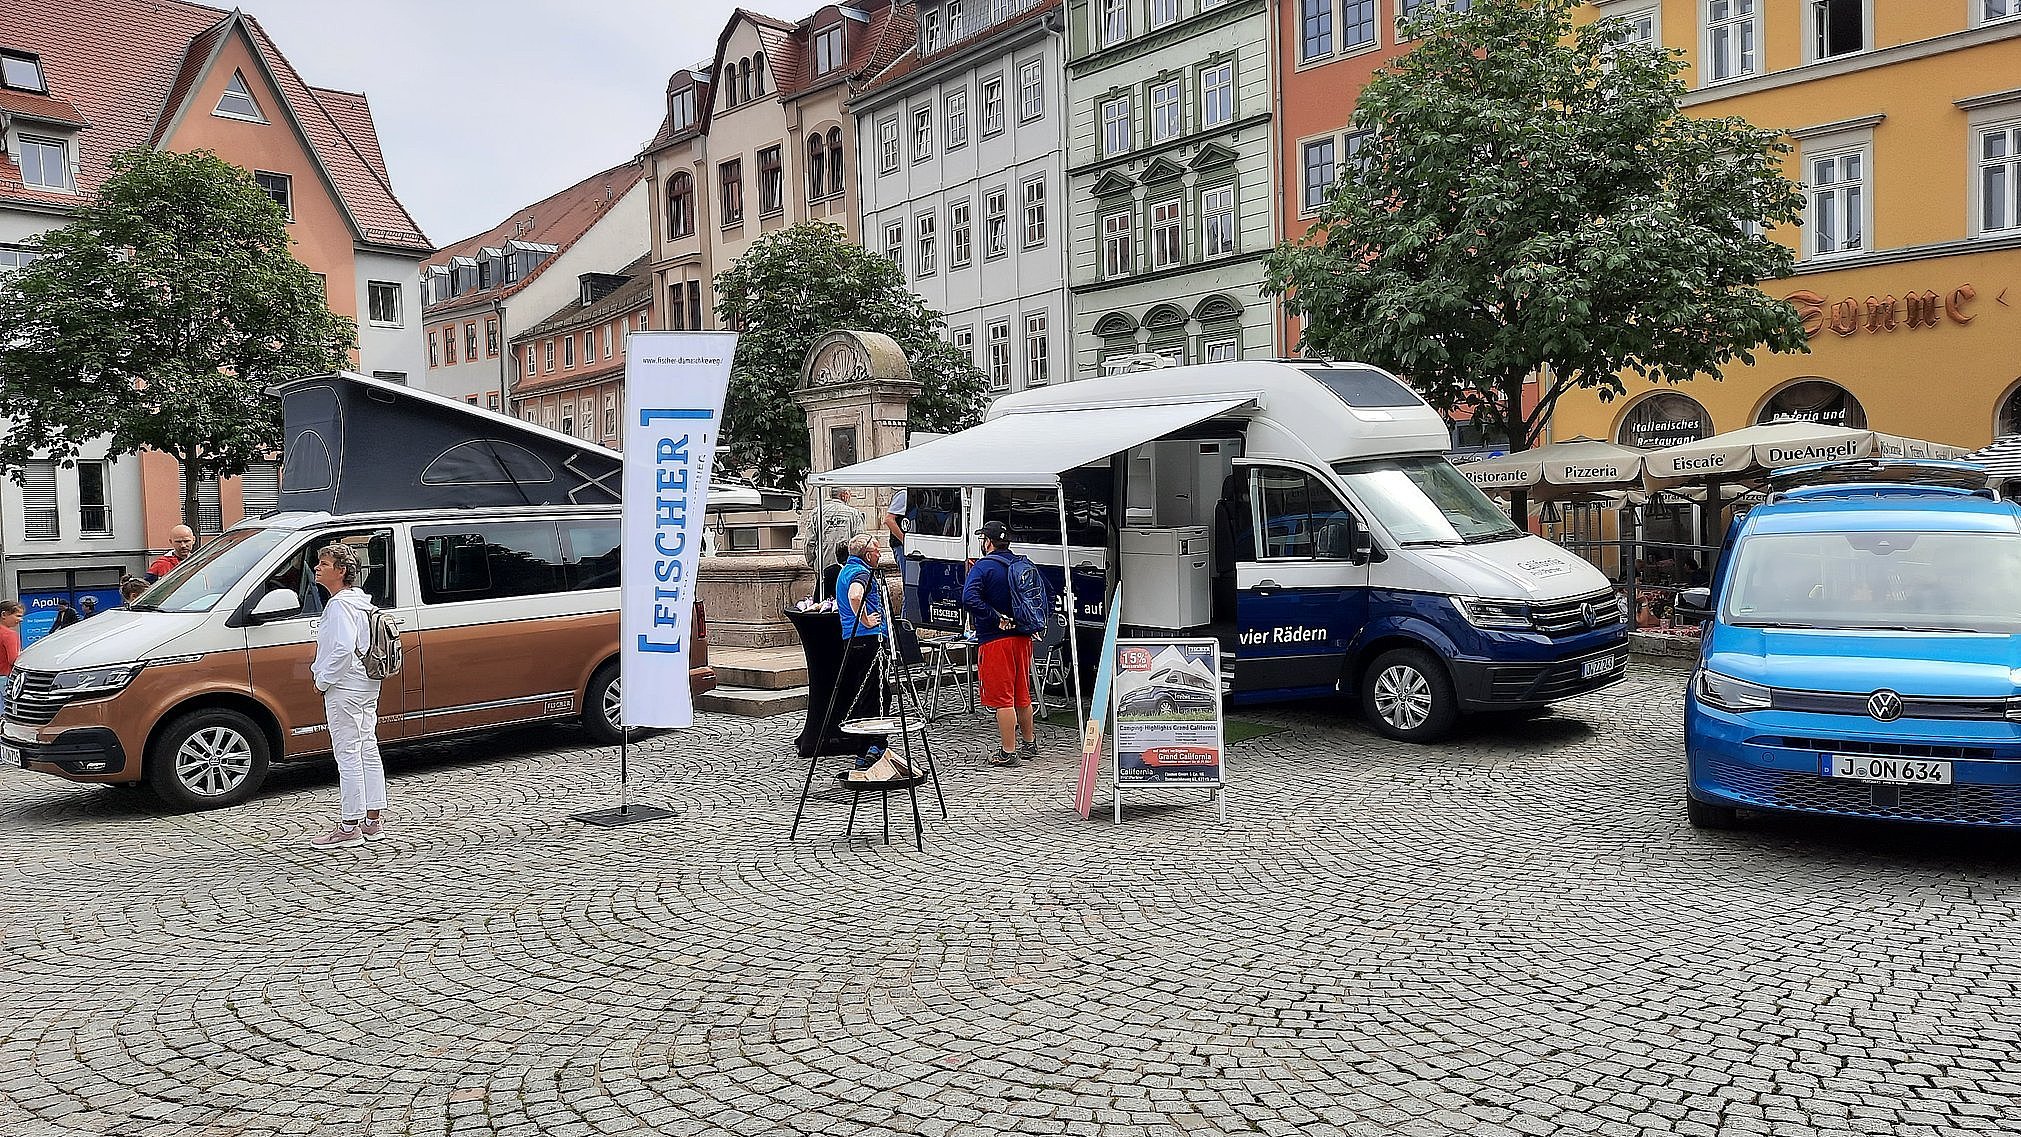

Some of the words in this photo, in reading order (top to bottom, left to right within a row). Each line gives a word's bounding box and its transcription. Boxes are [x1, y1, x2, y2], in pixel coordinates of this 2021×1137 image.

[1823, 408, 1846, 420] und
[1632, 419, 1699, 433] Italienisches
[1769, 440, 1857, 462] DueAngeli
[1466, 469, 1528, 483] Ristorante
[1565, 464, 1617, 478] Pizzeria
[653, 433, 689, 629] FISCHER
[32, 597, 60, 607] Apoll
[1084, 601, 1103, 615] auf
[1240, 628, 1270, 645] vier
[1273, 625, 1327, 643] Rädern
[1840, 758, 1854, 776] J
[1869, 760, 1897, 778] ON
[1901, 762, 1942, 781] 634
